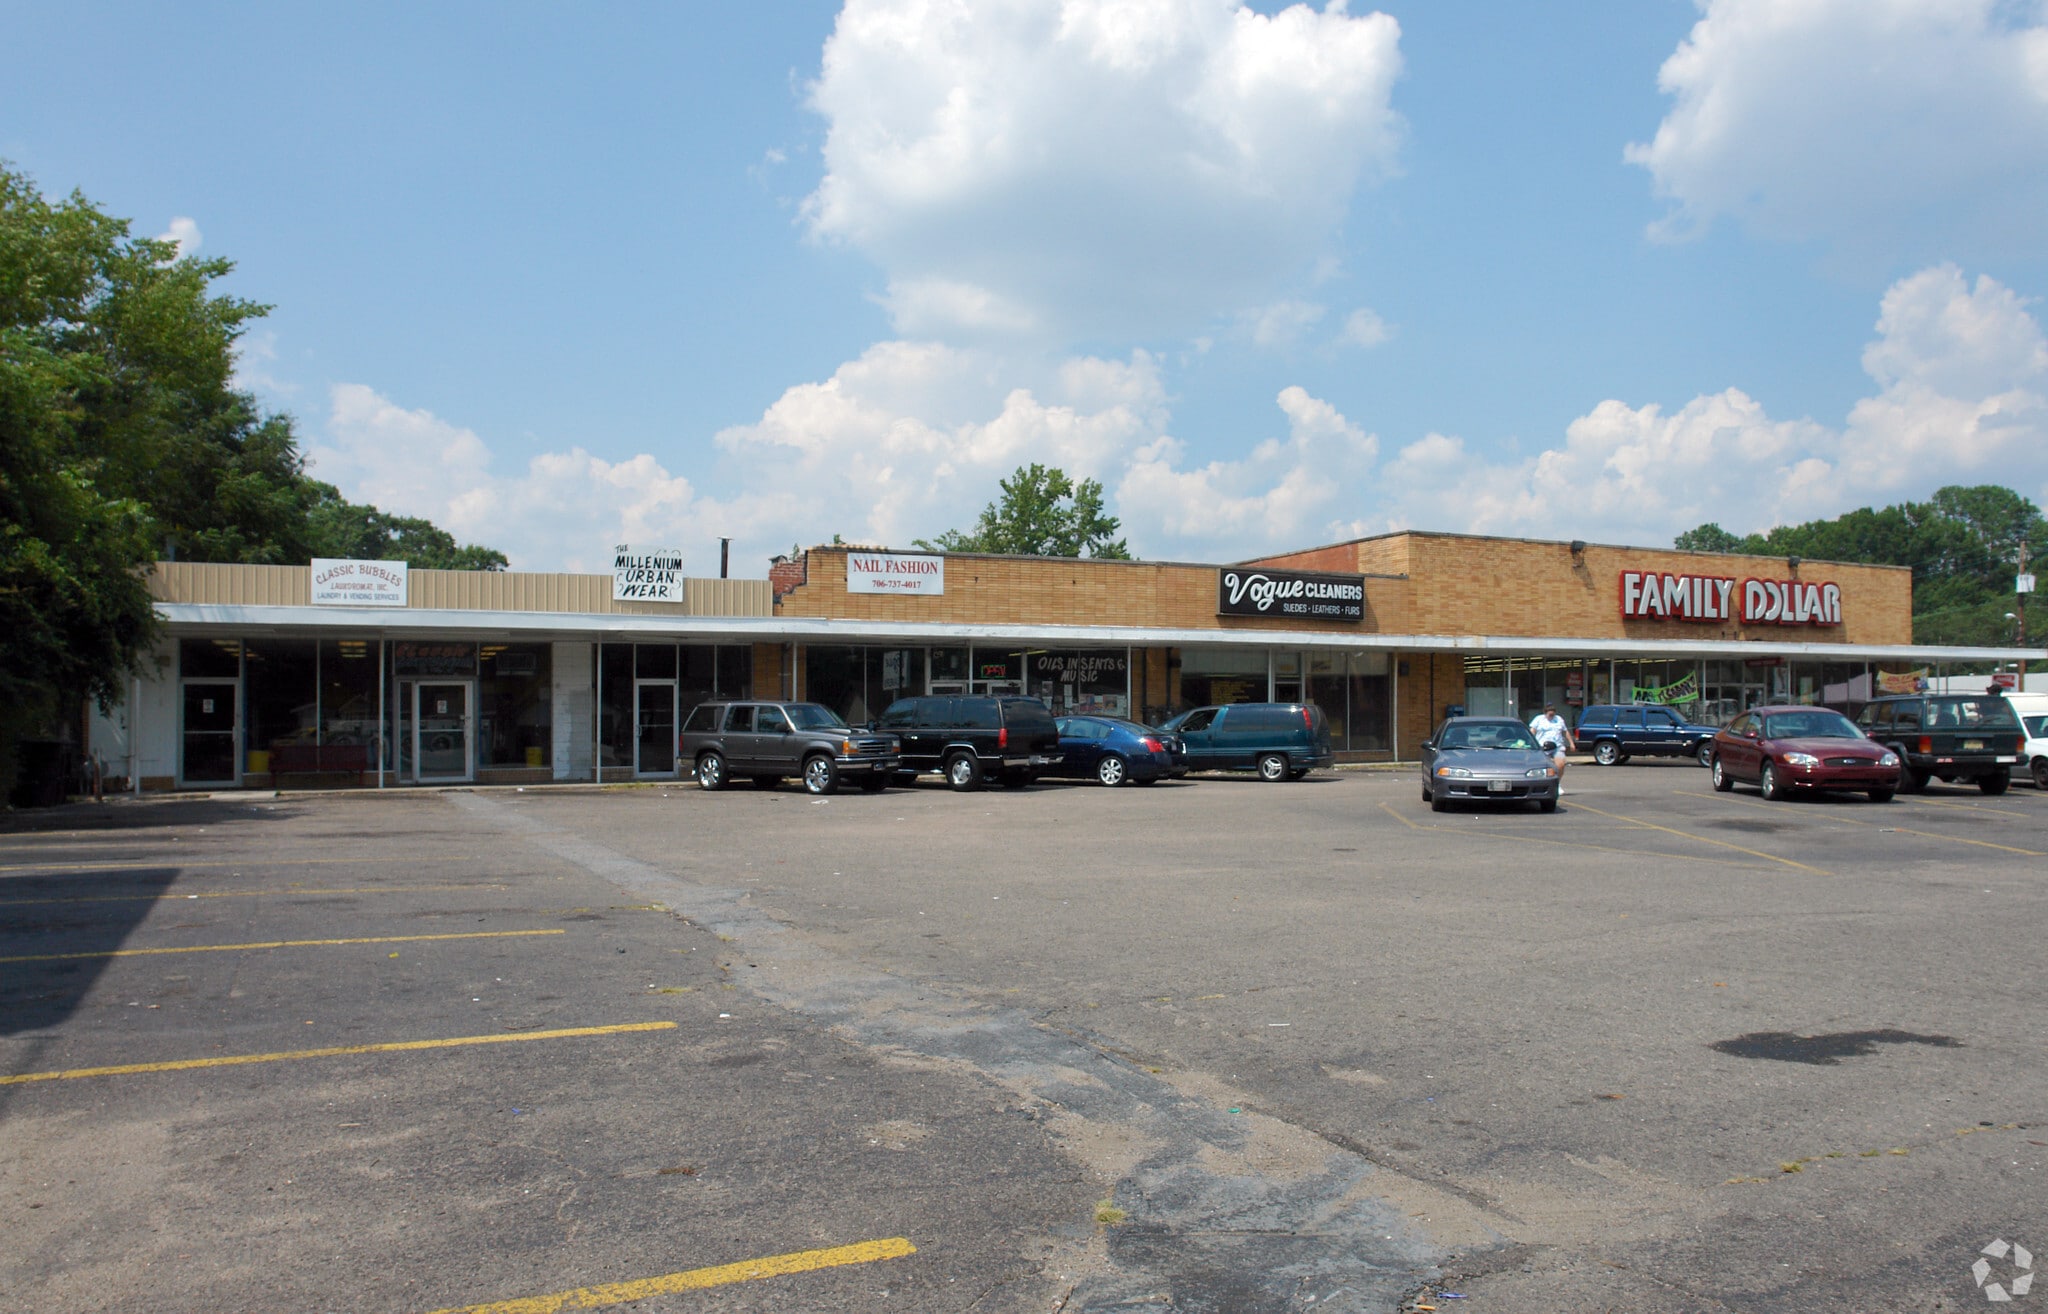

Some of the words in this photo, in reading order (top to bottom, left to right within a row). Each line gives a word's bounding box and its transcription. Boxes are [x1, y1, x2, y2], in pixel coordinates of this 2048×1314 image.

[615, 544, 628, 554] THE
[615, 555, 682, 570] MILLENIUM
[853, 559, 883, 573] NAIL
[885, 560, 938, 574] FASHION
[315, 564, 354, 585] CLASSIC
[359, 564, 402, 587] BUBBLES
[625, 569, 675, 584] URBAN
[622, 584, 668, 598] WEAR
[872, 580, 922, 589] 706-737-4017
[1224, 573, 1304, 611] Vogue
[1305, 582, 1362, 600] CLEANERS
[1624, 573, 1734, 619] FAMILY
[1745, 580, 1841, 622] DOLLAR
[1283, 603, 1307, 613] SUEDES
[1312, 605, 1340, 614] LEATHERS
[1345, 606, 1360, 615] FURS
[1038, 656, 1064, 670] OILS
